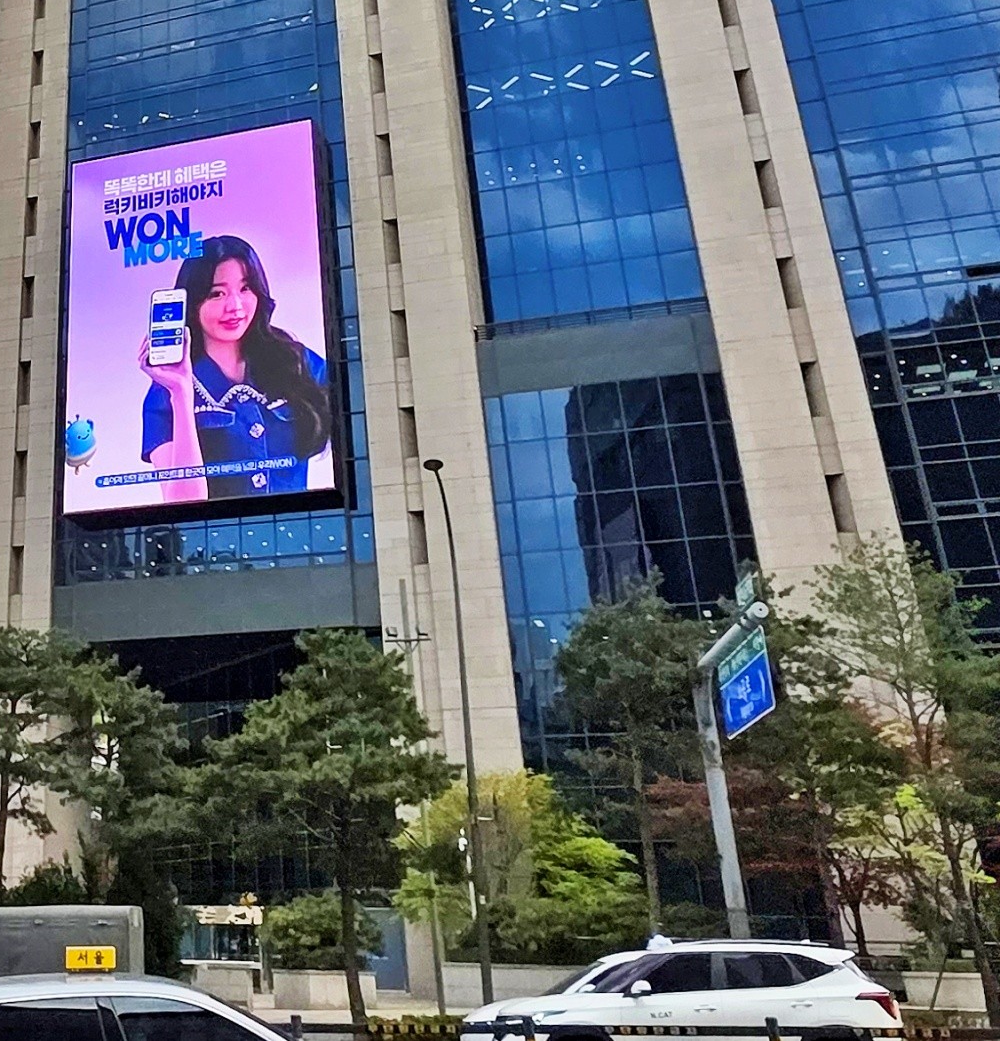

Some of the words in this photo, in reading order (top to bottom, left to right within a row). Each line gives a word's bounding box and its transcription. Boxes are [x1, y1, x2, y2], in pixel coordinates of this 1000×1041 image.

[103, 171, 172, 196] 똑똑한데
[174, 160, 227, 187] 혜택은
[103, 180, 224, 215] 럭키비키해야지
[104, 207, 190, 250] WON
[124, 231, 204, 268] MORE
[77, 950, 105, 965] 서울
